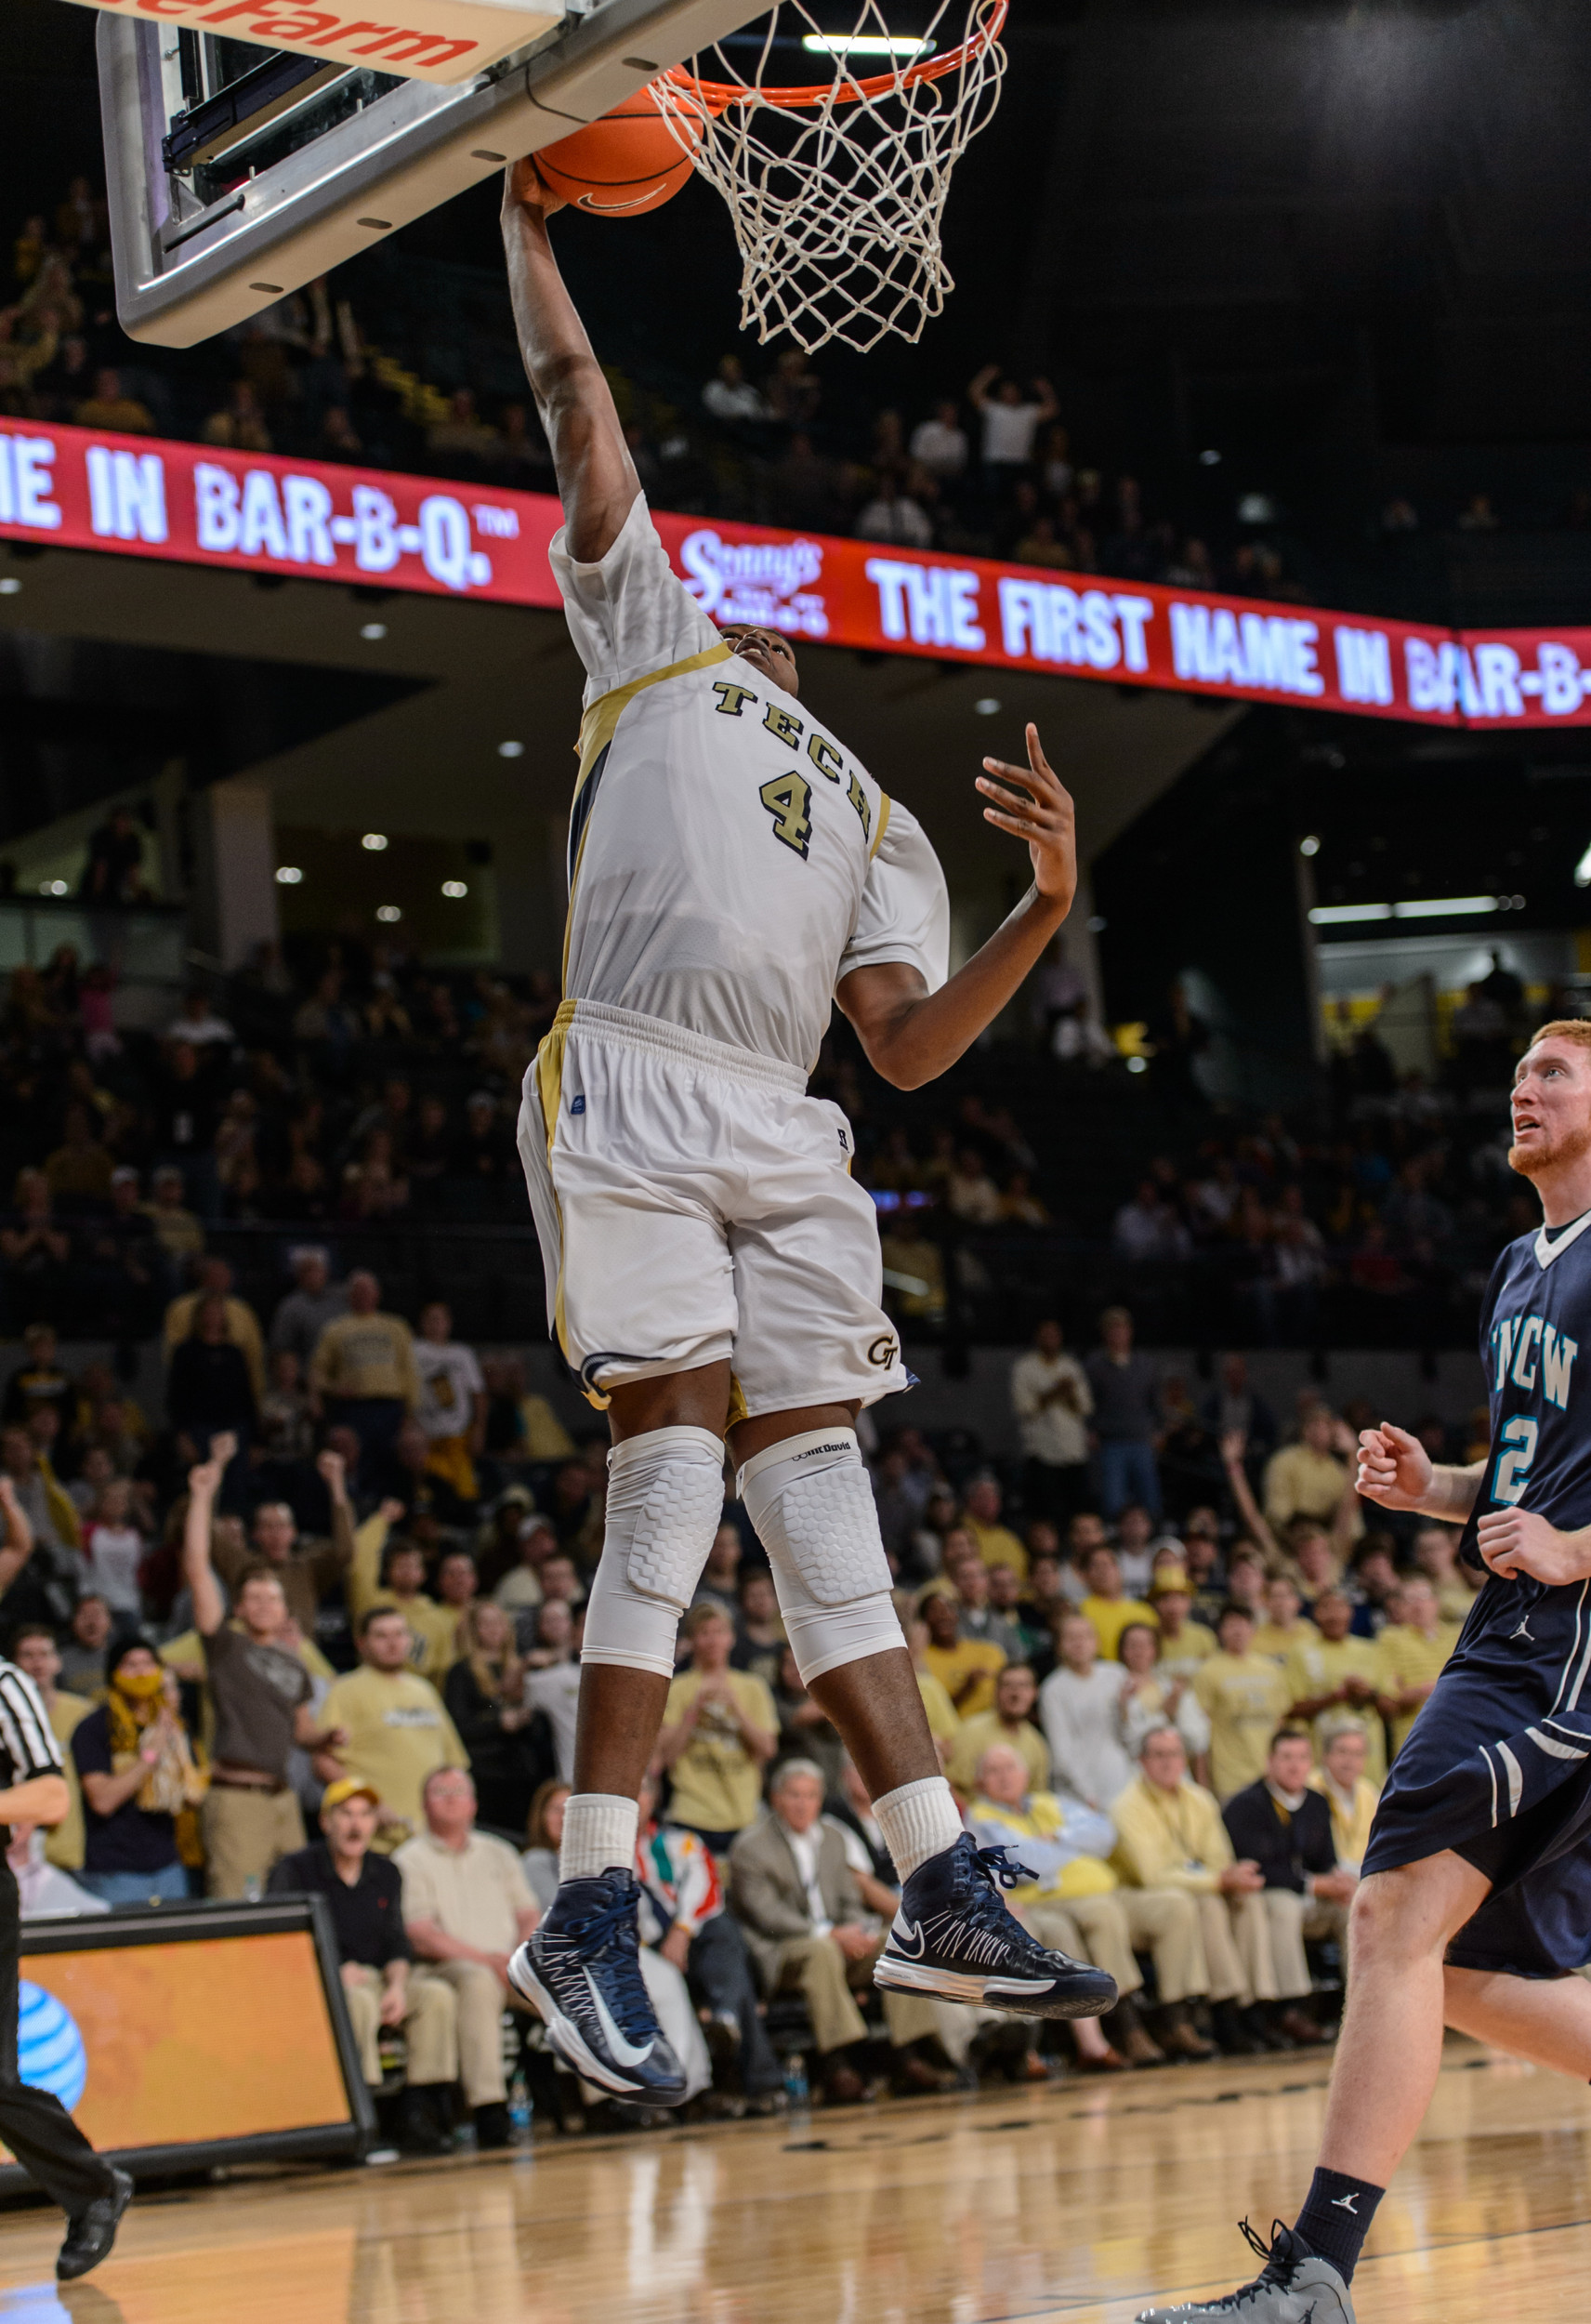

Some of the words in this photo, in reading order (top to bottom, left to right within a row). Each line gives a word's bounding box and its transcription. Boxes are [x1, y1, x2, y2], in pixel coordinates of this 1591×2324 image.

[86, 445, 168, 544] IN
[865, 558, 986, 652] THE
[997, 576, 1154, 674] FIRST
[1168, 602, 1325, 698] NAME
[1334, 625, 1395, 706] IN
[712, 681, 871, 845] TECH
[758, 770, 813, 862] 4
[867, 1335, 899, 1371] GT
[1490, 1413, 1539, 1506] 2
